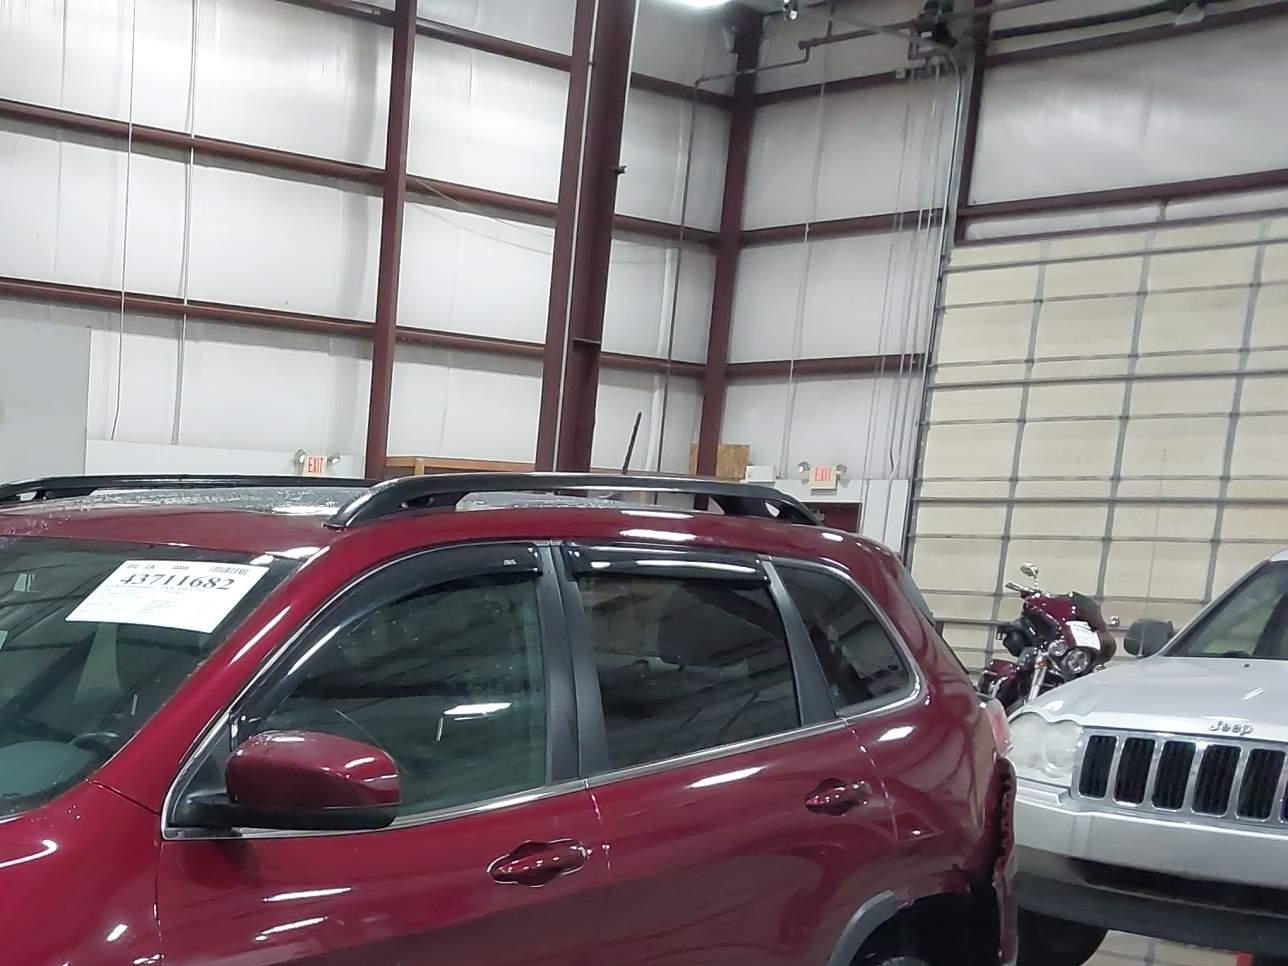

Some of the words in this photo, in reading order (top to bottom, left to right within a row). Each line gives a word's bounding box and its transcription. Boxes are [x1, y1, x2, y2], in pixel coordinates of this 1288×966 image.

[308, 456, 325, 473] EXIT
[814, 467, 833, 482] EXIT
[120, 573, 235, 591] 43711682
[1208, 719, 1254, 736] Jeep
